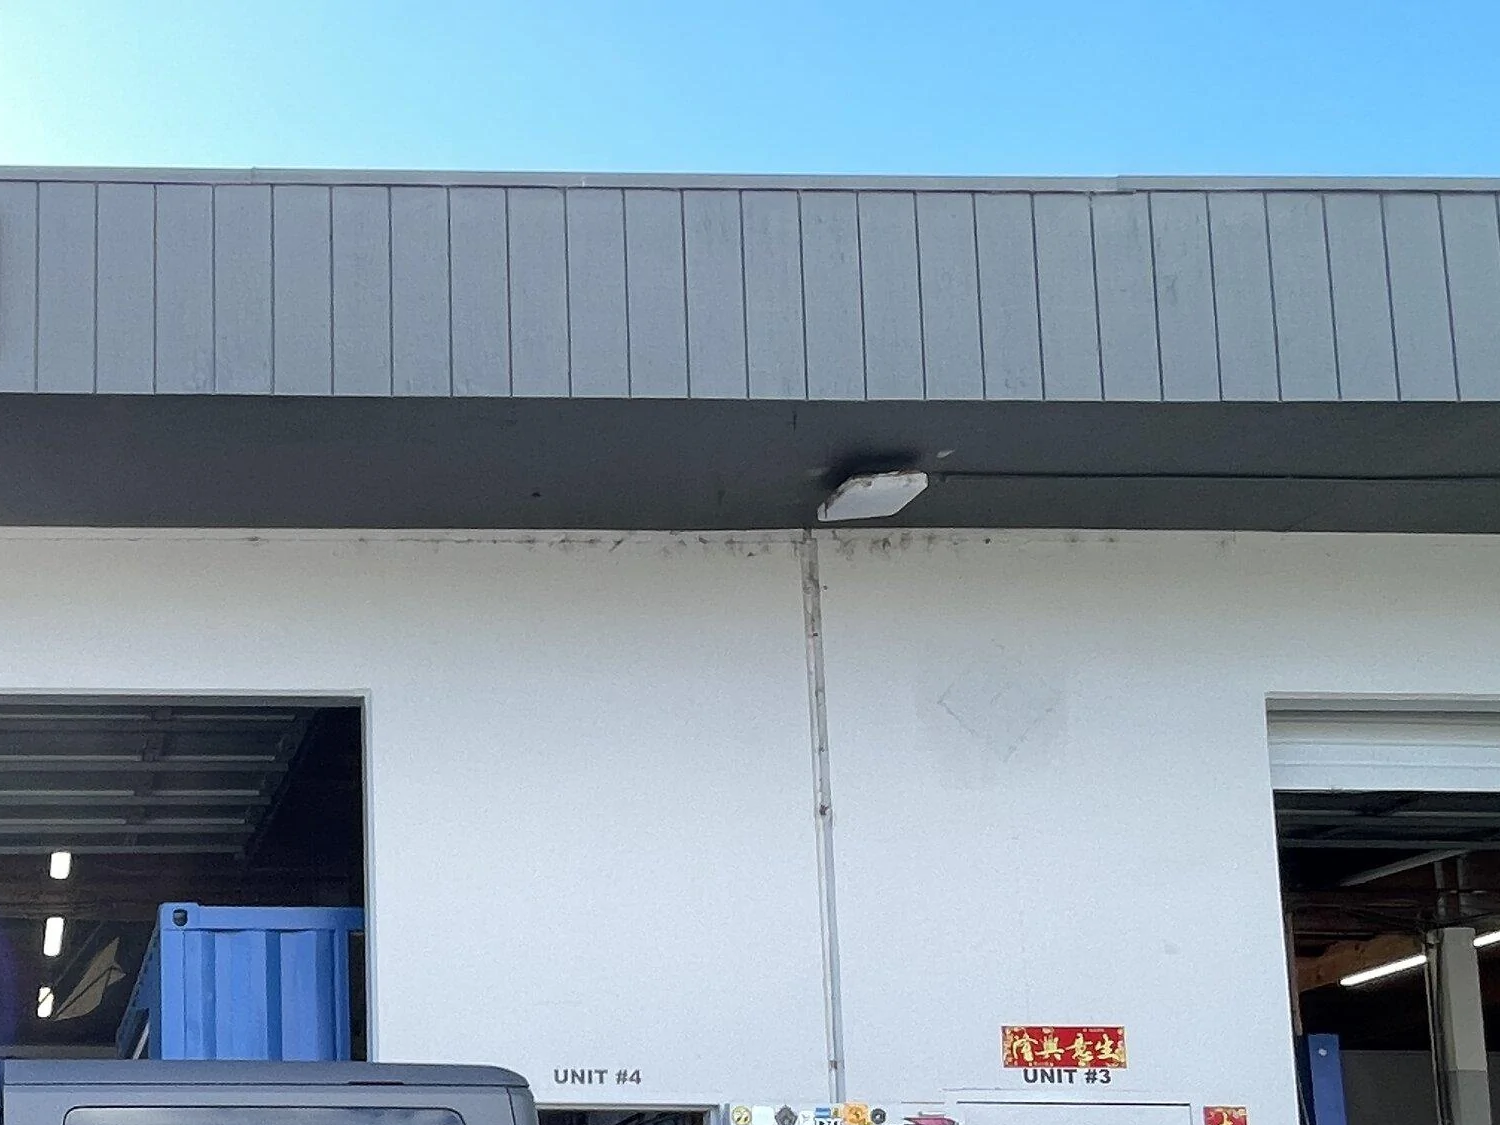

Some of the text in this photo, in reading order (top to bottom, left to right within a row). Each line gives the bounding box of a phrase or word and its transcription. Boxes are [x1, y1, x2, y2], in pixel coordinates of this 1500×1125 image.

[553, 1068, 642, 1085] UNIT #4
[1023, 1068, 1112, 1084] UNIT #3
